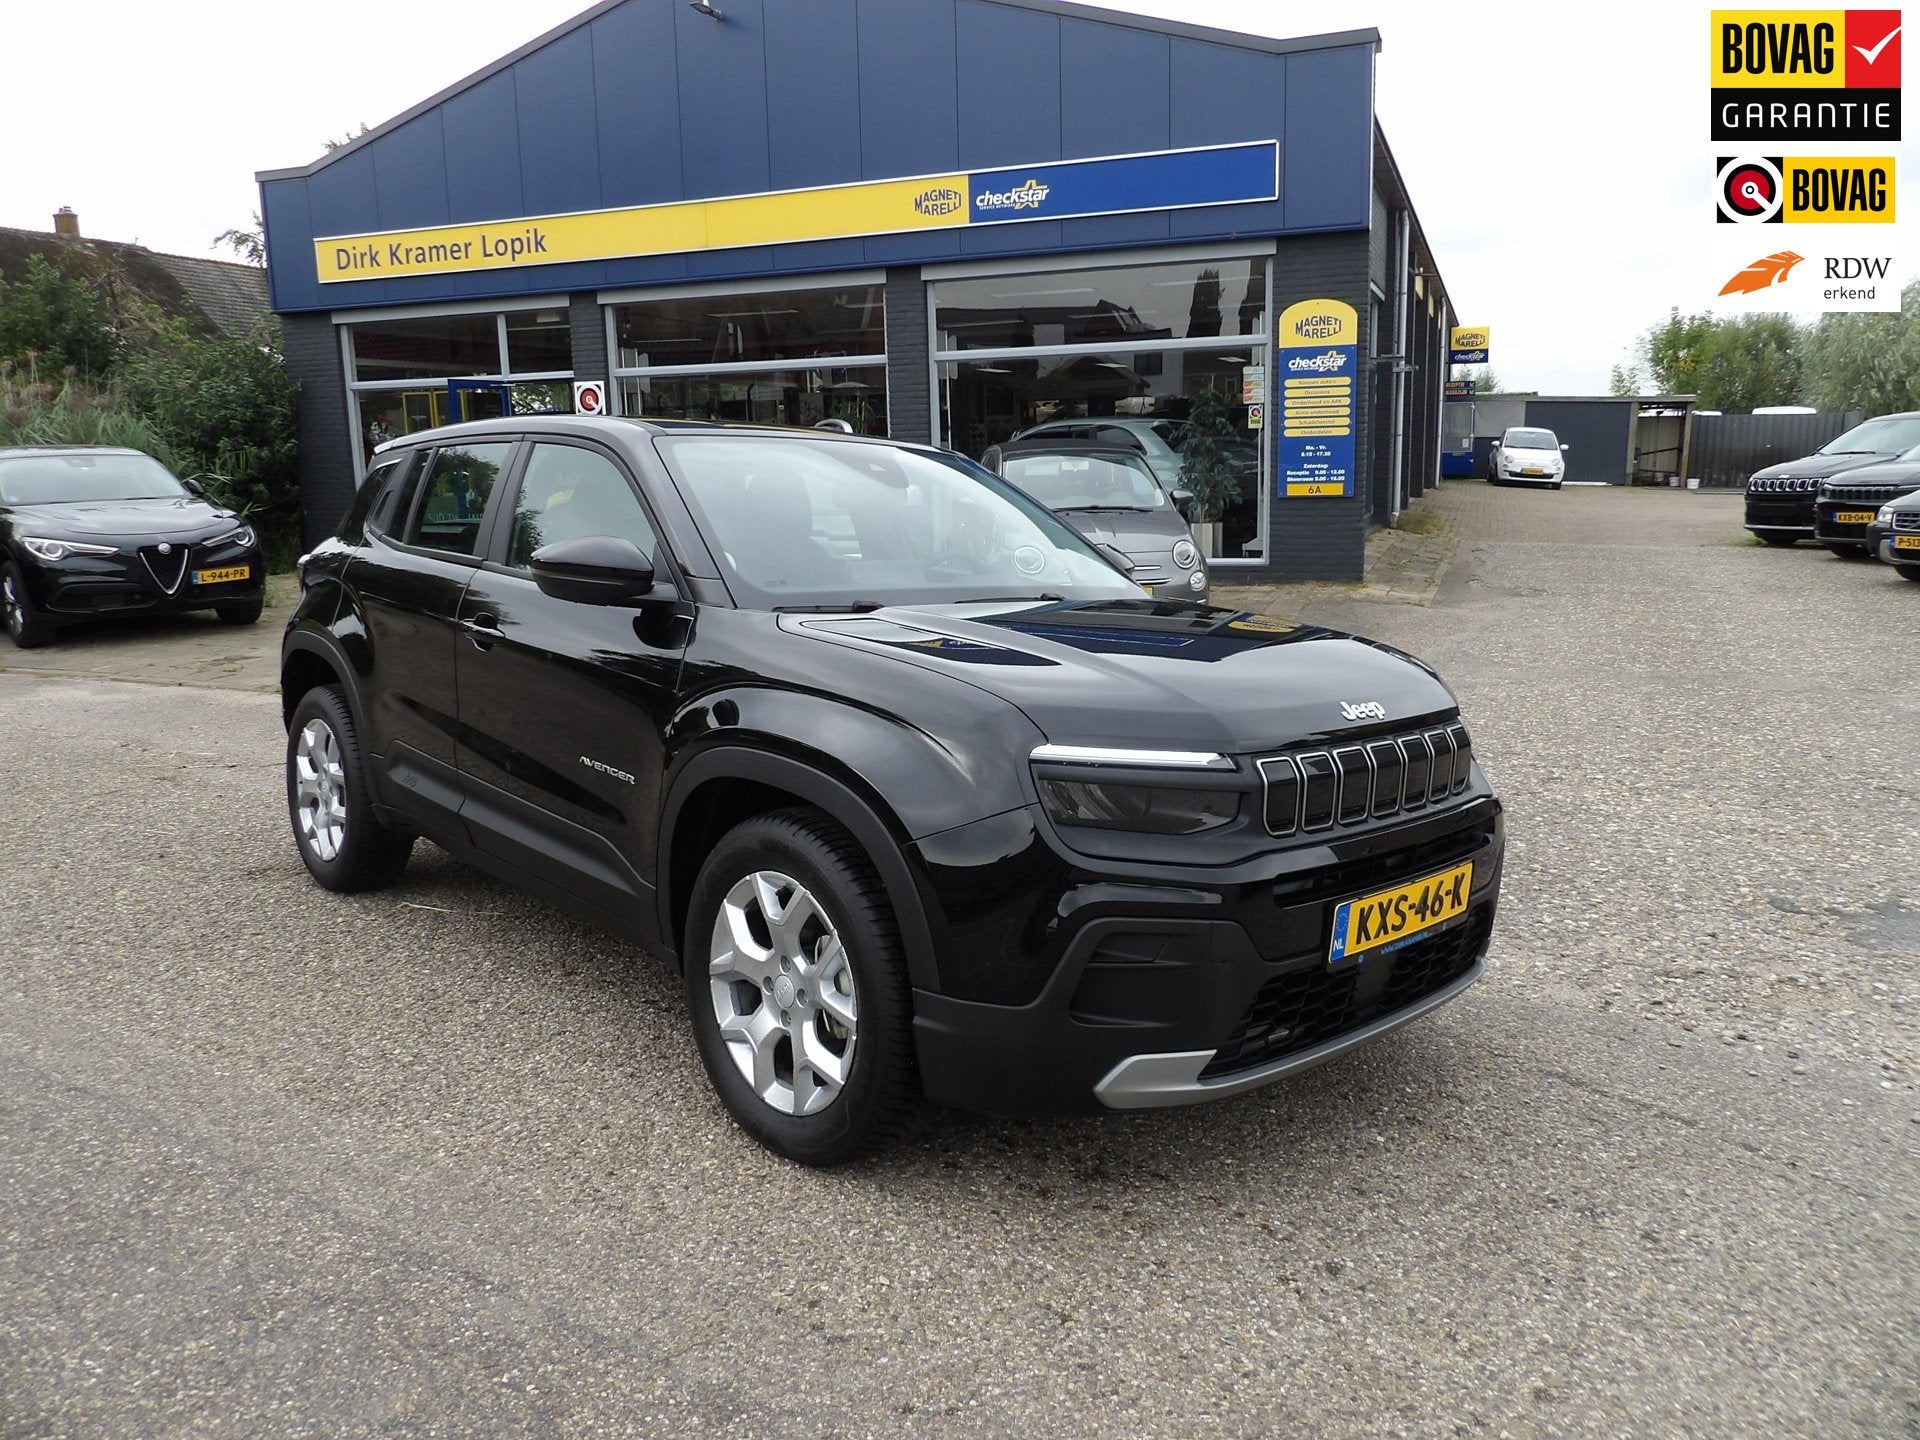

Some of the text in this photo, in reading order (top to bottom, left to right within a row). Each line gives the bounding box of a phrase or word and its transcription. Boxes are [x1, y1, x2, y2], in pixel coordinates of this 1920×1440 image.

[915, 189, 962, 207] MAGNETI
[976, 187, 1050, 207] checkstar
[915, 197, 962, 216] MARELLI
[336, 228, 547, 270] Dirk Kramer Lopik
[1295, 315, 1342, 331] MAGNETI
[1295, 324, 1342, 339] MARELLI
[1288, 355, 1347, 369] checkstar
[1308, 485, 1322, 494] 6A
[201, 569, 246, 582] L-944-PR
[1340, 701, 1386, 721] Jeep
[580, 756, 635, 785] AVENGER
[1355, 872, 1465, 945] KXS-46-K
